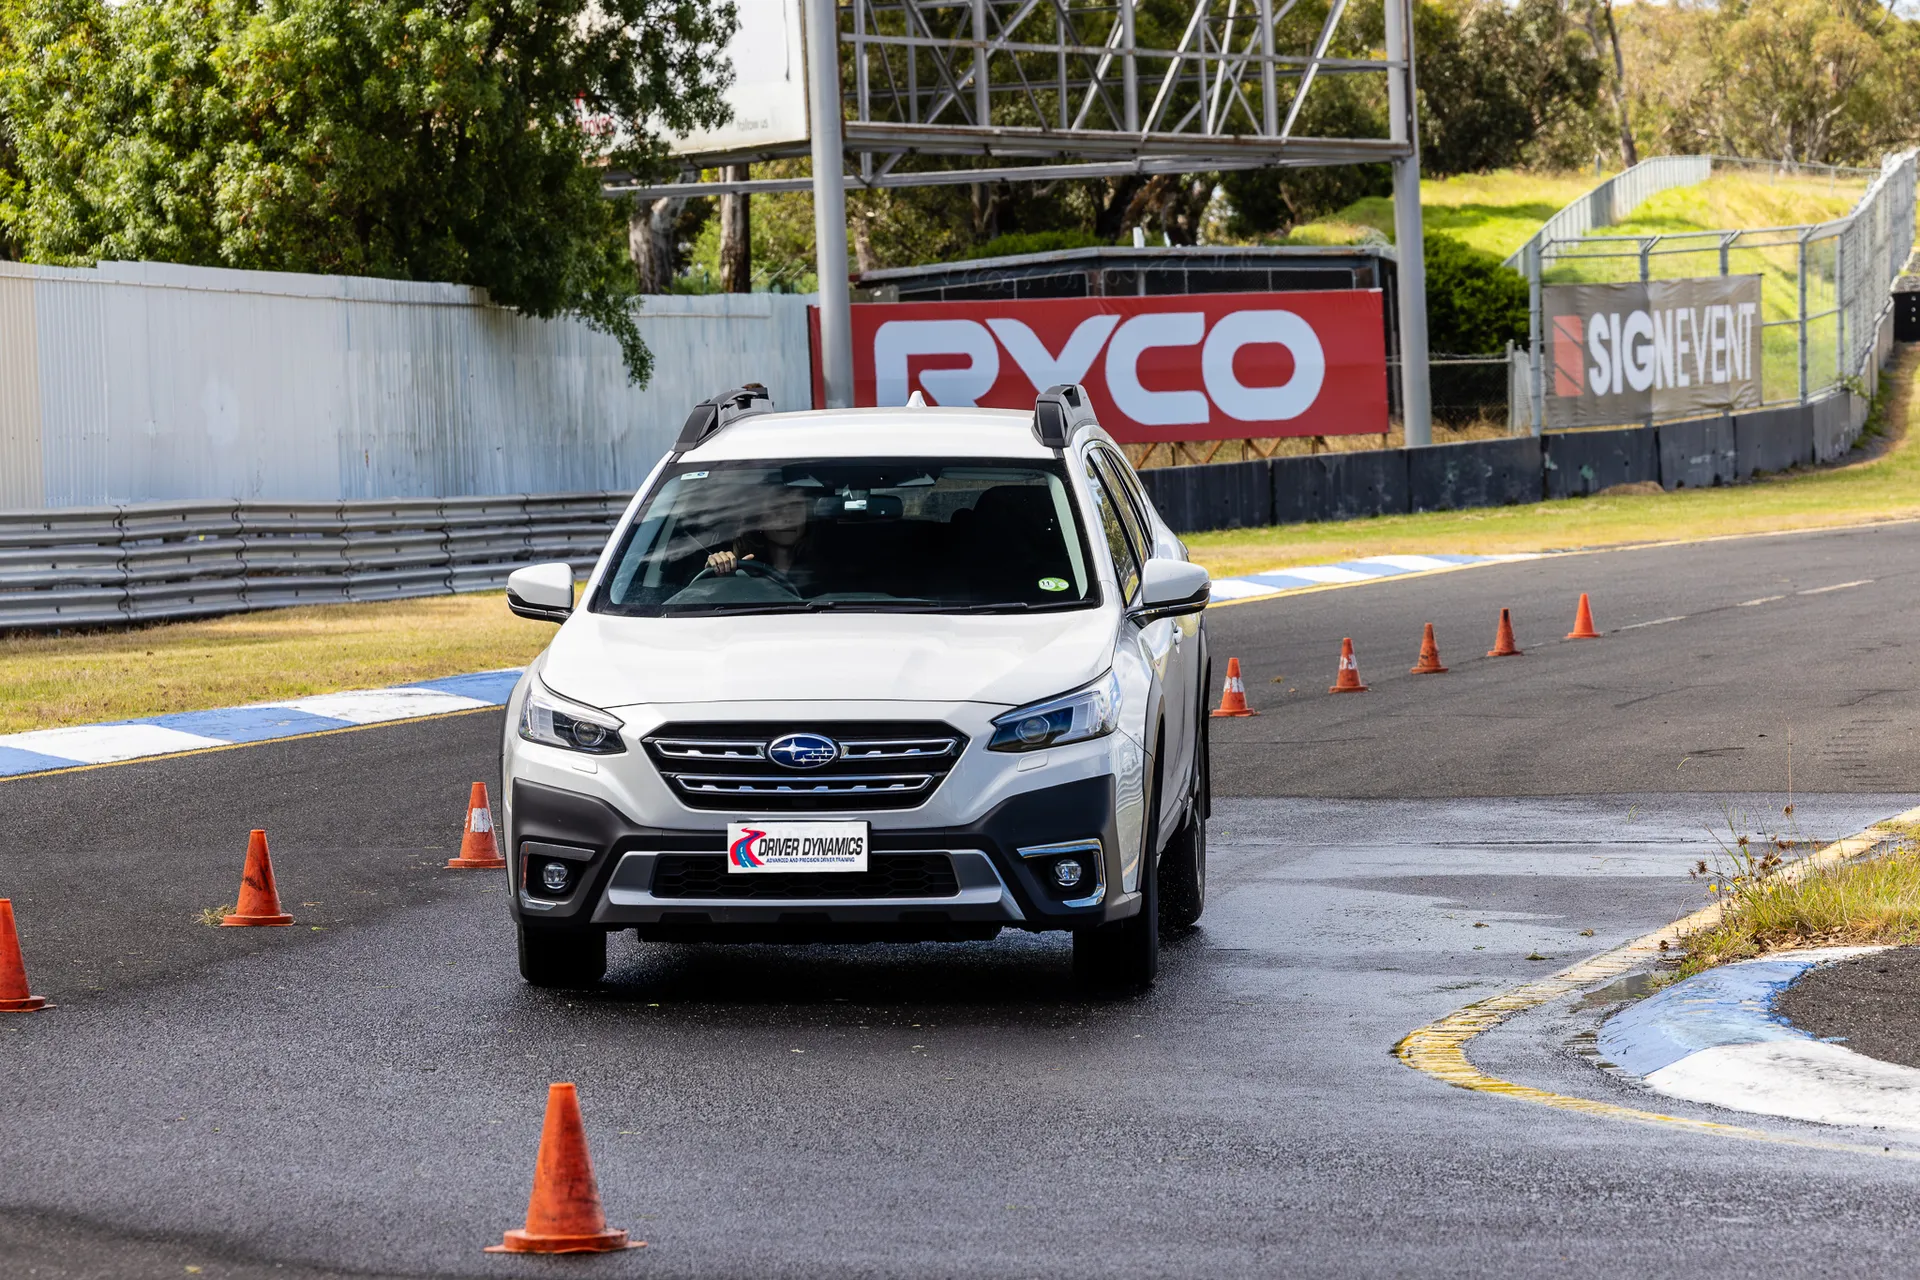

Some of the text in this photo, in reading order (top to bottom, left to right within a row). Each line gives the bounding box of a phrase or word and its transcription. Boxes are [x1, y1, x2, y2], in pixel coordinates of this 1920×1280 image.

[874, 309, 1326, 425] RYCO
[1588, 302, 1756, 396] SIGNEVENT
[758, 837, 864, 856] DRIVER DYNAMICS
